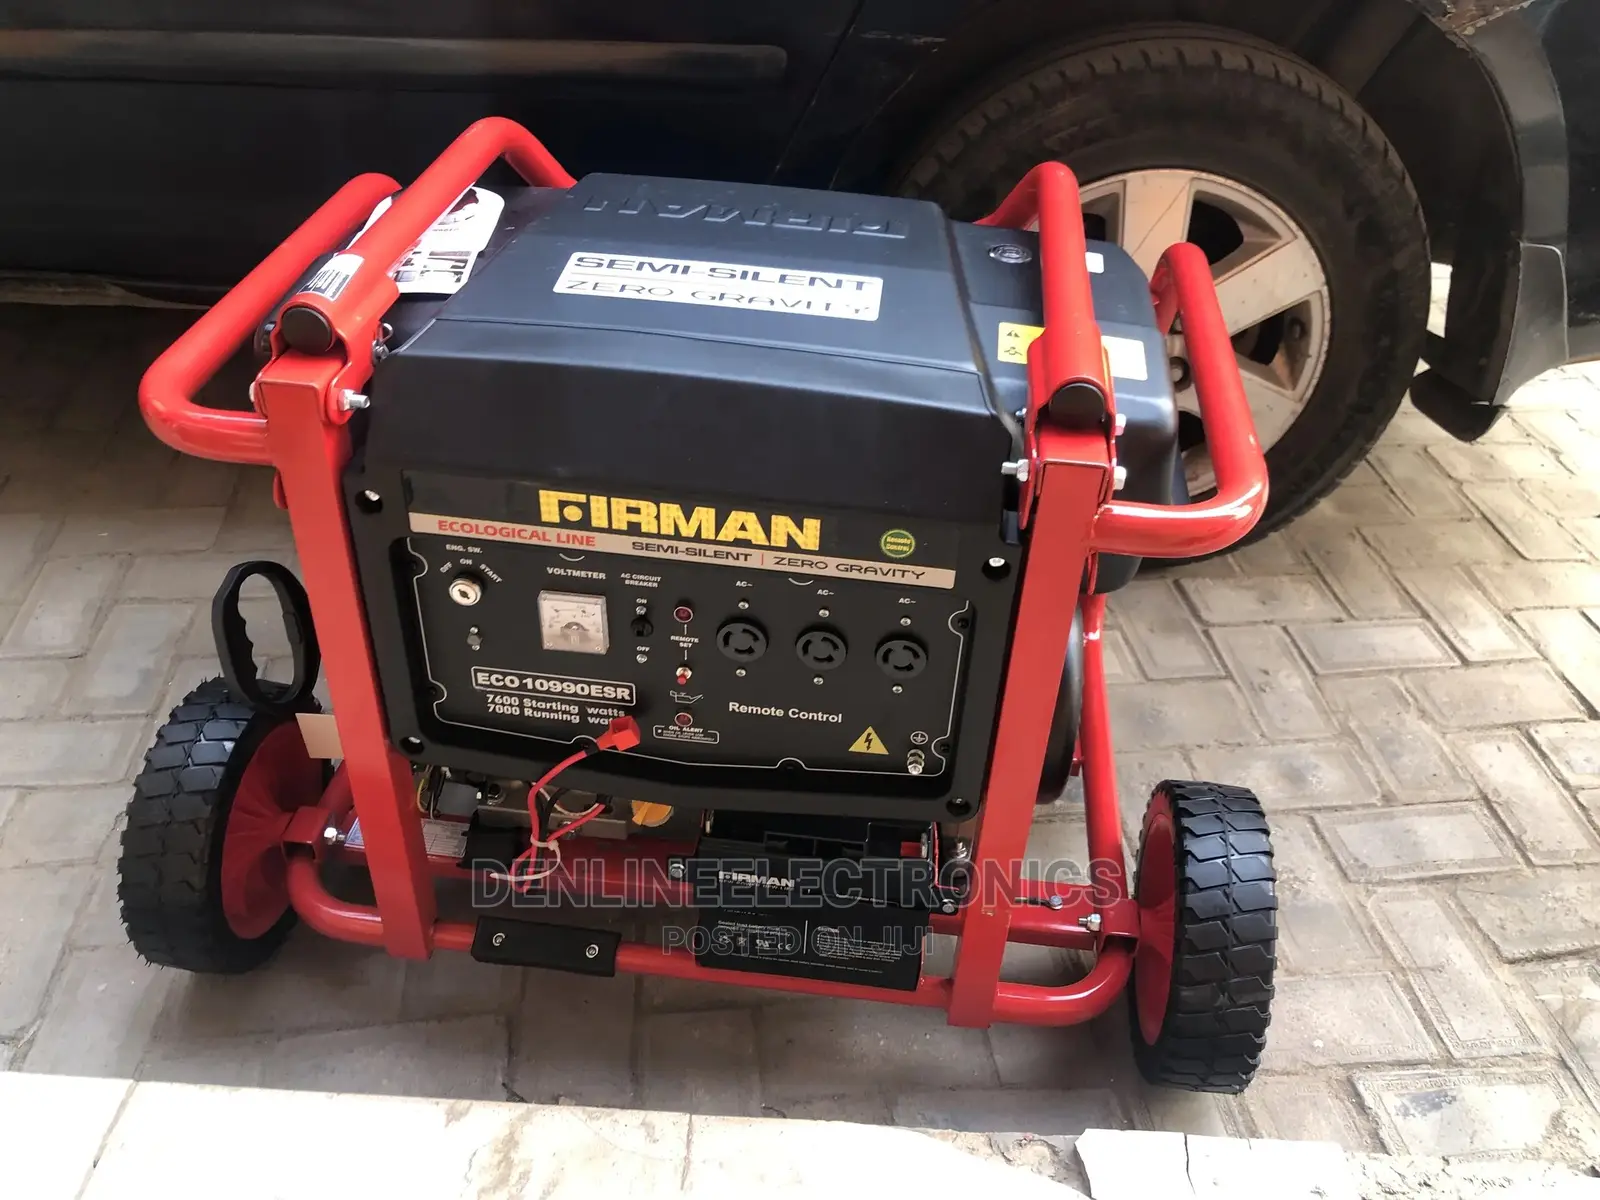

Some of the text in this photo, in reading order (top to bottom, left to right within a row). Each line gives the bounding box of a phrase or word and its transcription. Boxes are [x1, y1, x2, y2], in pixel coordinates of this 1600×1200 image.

[574, 256, 877, 292] SEMI-SILENT
[565, 279, 674, 297] ZERO
[538, 489, 821, 551] FIRMAN
[437, 519, 596, 547] ECOLOGICAL LINE
[445, 543, 466, 552] ENG.
[631, 541, 752, 562] SEMI-SILENT
[440, 561, 453, 573] OFF
[480, 563, 503, 583] START
[546, 566, 606, 580] VOLTMETER
[772, 556, 926, 580] ZERO GRAVITY
[625, 580, 658, 588] BREAKER
[632, 573, 661, 582] CIRCUIT
[670, 635, 699, 643] REMOTE
[486, 693, 625, 718] 7600 Starting watts
[487, 703, 520, 716] 7000
[524, 707, 580, 724] Running
[728, 702, 843, 723] Remote Control
[718, 870, 795, 888] FIRMAN
